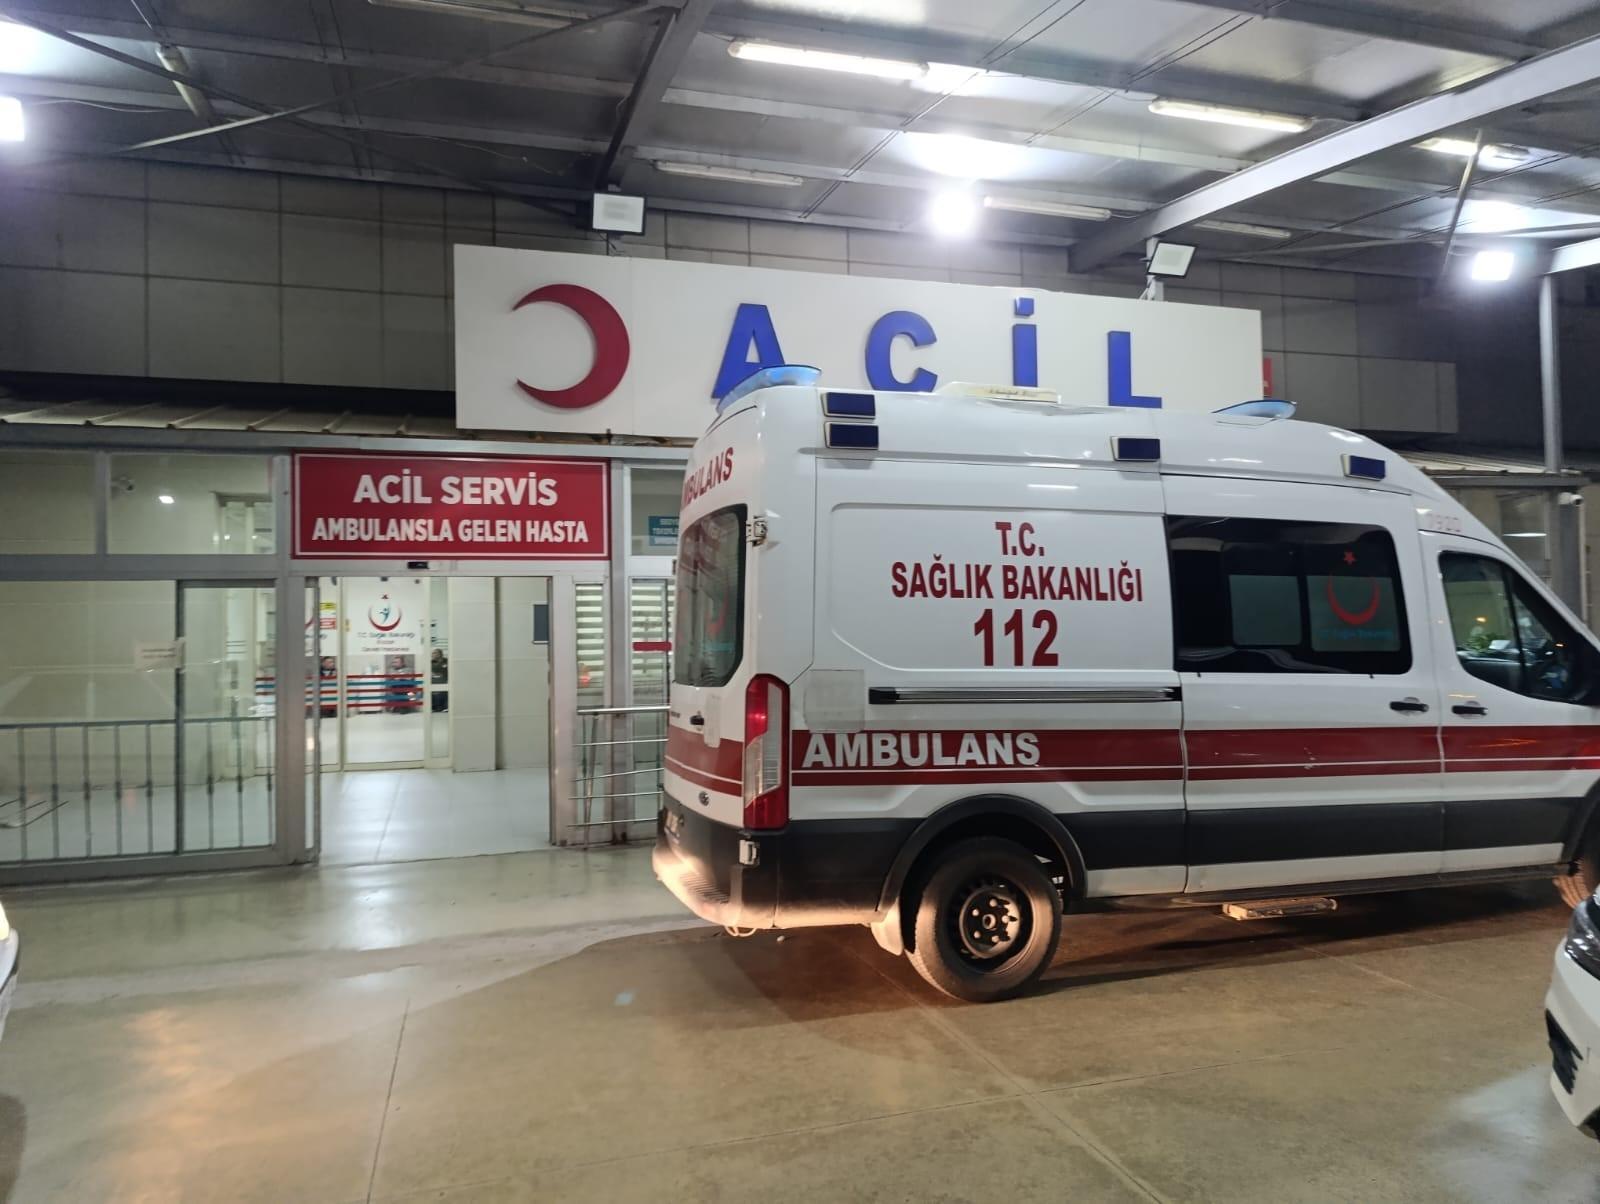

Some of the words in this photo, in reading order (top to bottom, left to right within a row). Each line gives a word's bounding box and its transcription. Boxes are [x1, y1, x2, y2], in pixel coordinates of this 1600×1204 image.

[711, 296, 1162, 409] ACİL
[353, 469, 432, 504] ACİL
[441, 472, 558, 506] SERVİS
[312, 517, 453, 542] AMBULANSLA
[458, 518, 522, 542] GELEN
[526, 520, 589, 543] HASTA
[995, 521, 1045, 556] T.C.
[891, 553, 993, 599] SAĞLIK
[1003, 560, 1144, 602] BAKANLIĞI
[974, 608, 1059, 667] 112
[801, 732, 1041, 768] AMBULANS
